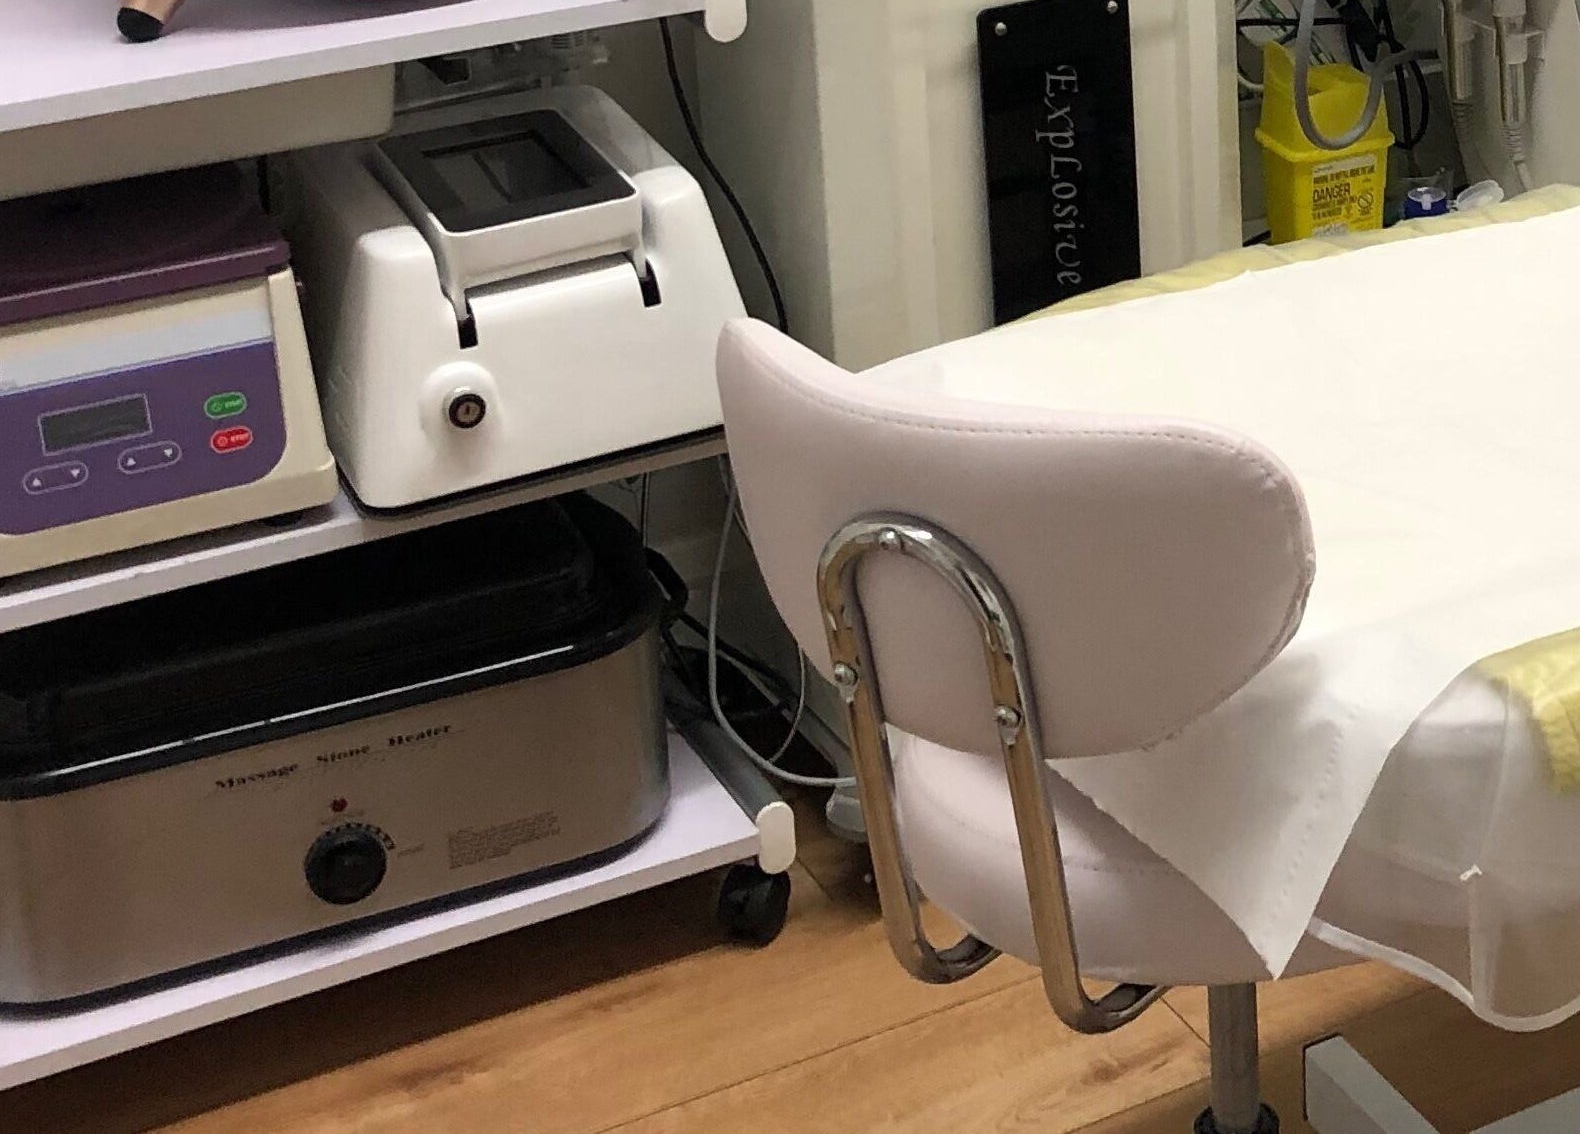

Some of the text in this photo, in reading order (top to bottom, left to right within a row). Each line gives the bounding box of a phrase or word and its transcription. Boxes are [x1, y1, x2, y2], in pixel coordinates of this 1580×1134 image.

[1313, 182, 1351, 203] DANGER
[215, 725, 451, 789] Massage Stone Heater
